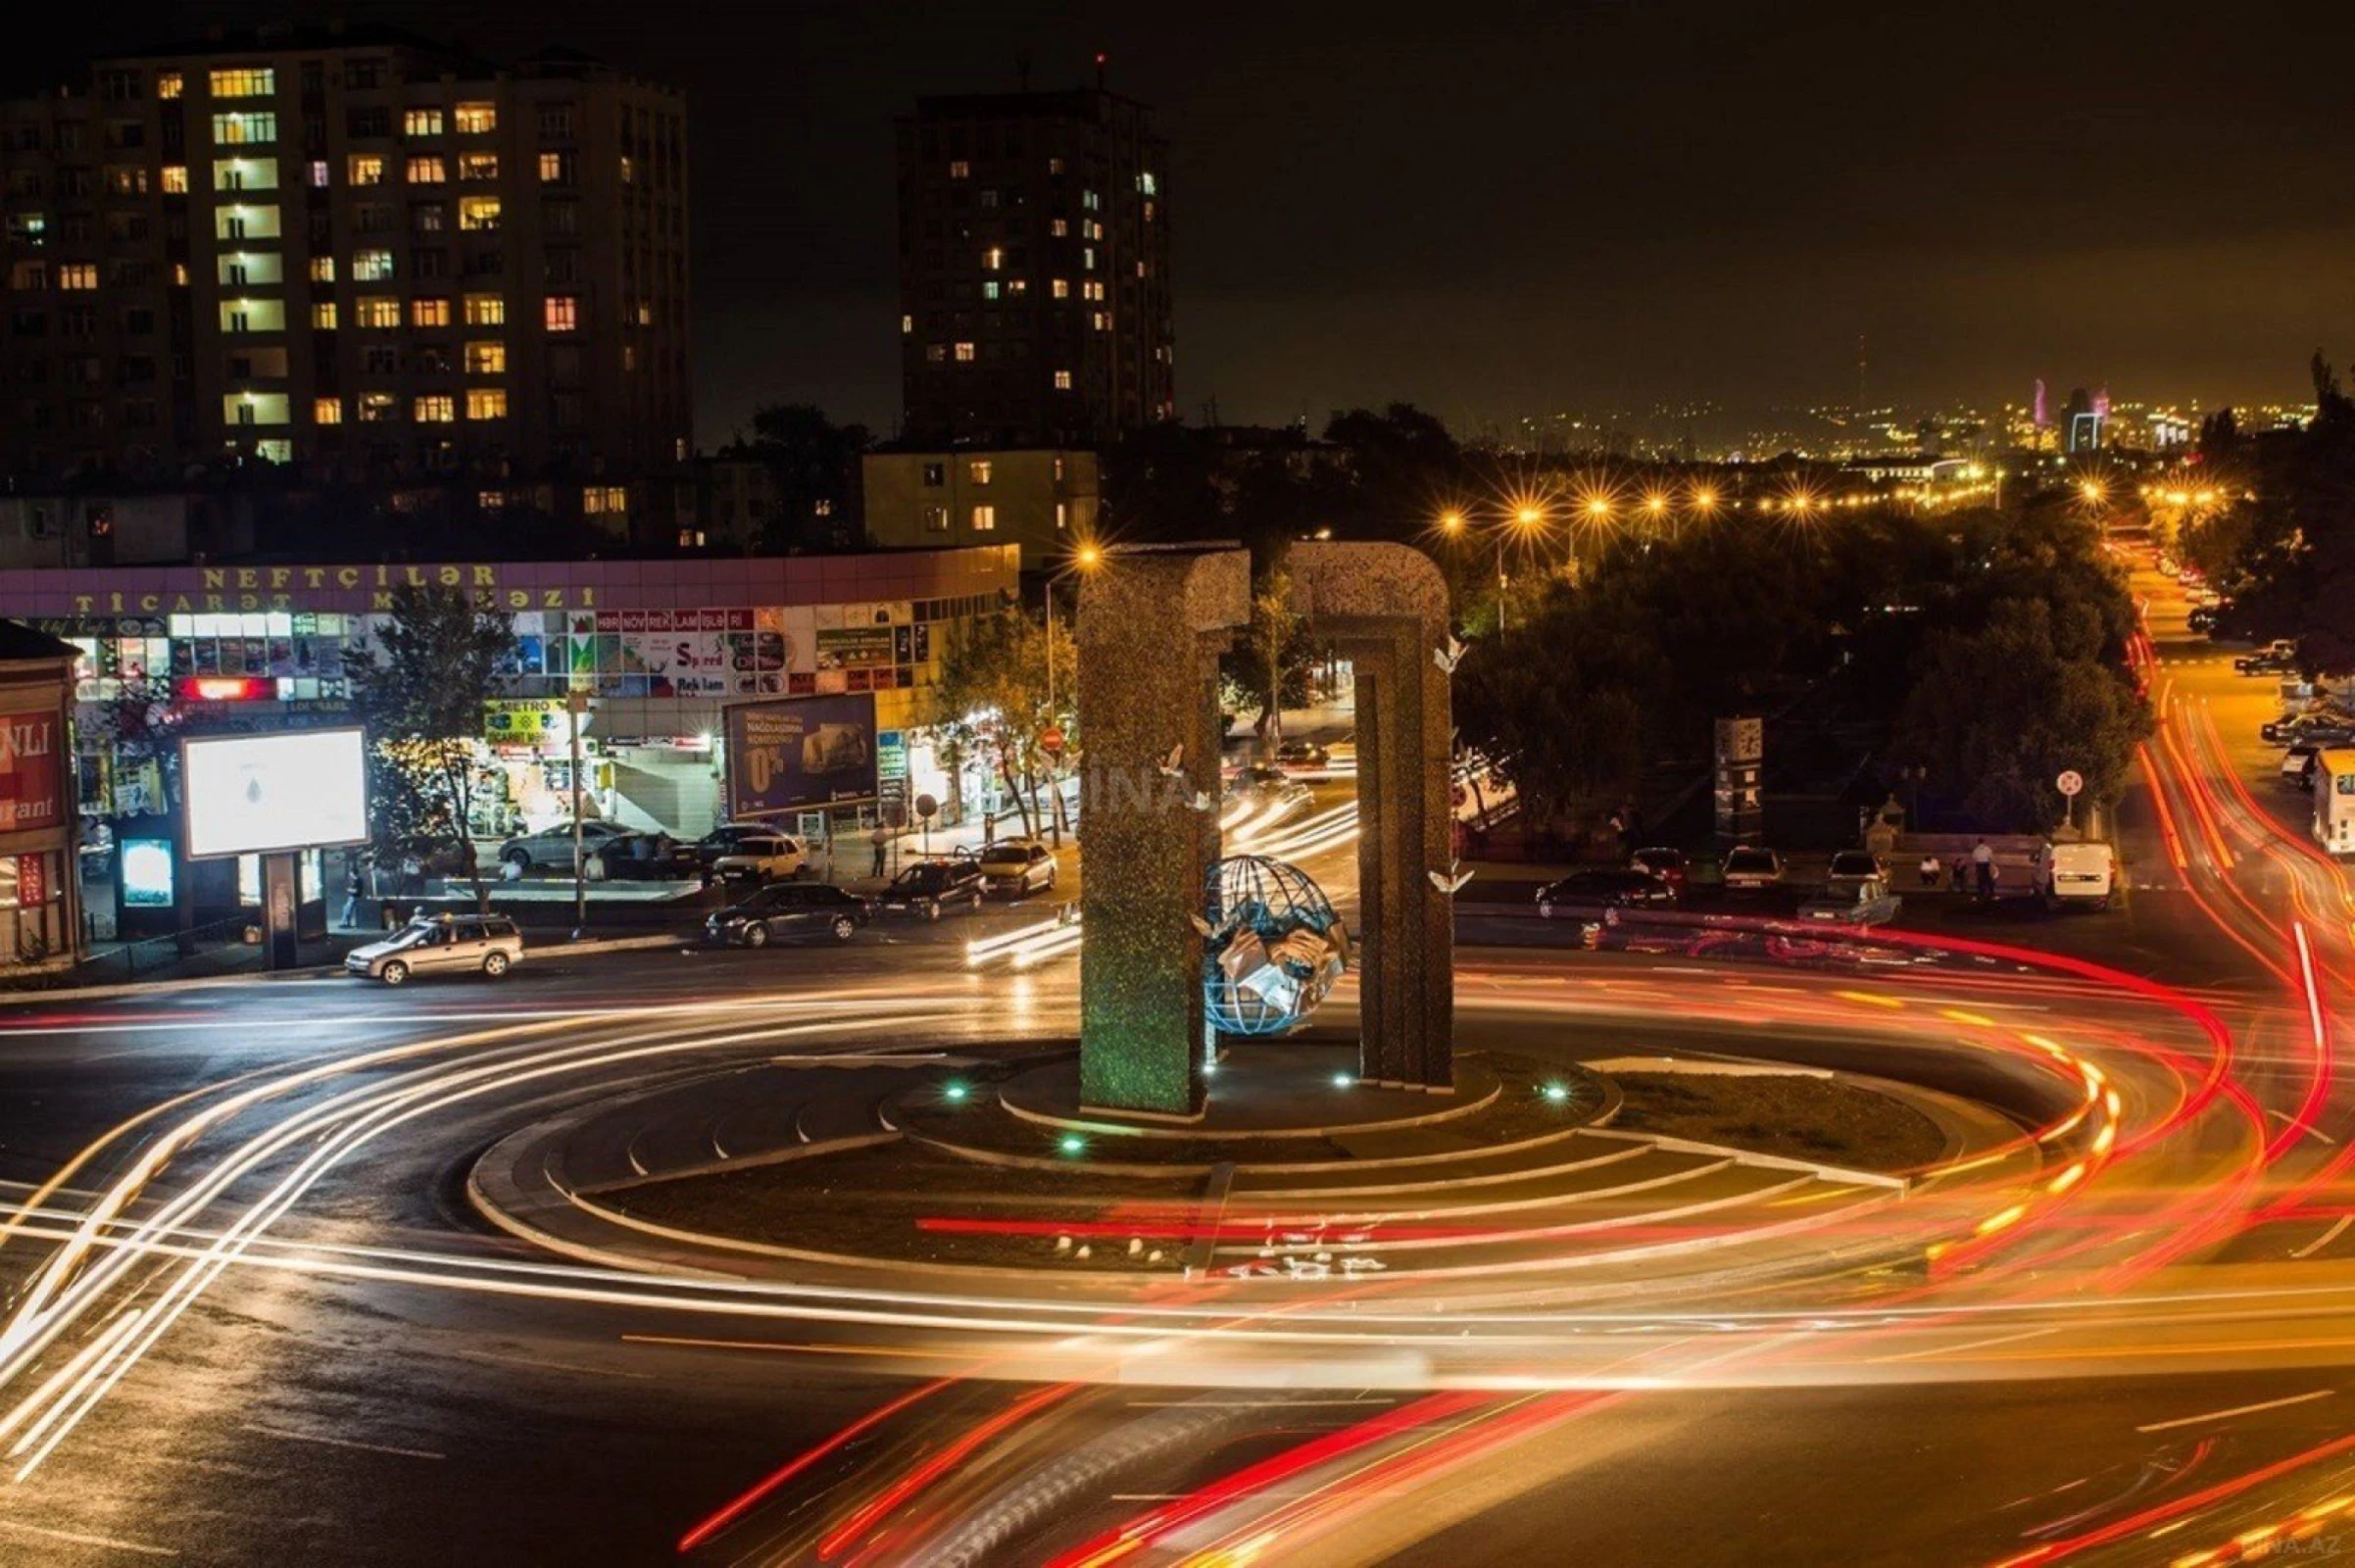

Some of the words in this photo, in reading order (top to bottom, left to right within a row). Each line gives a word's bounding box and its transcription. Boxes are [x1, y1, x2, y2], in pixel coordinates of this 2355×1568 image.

[204, 564, 495, 589] NEFTÇİLƏR
[76, 592, 291, 612] TİCARƏT
[373, 587, 593, 610] MƏZİ
[0, 720, 50, 758] NLI
